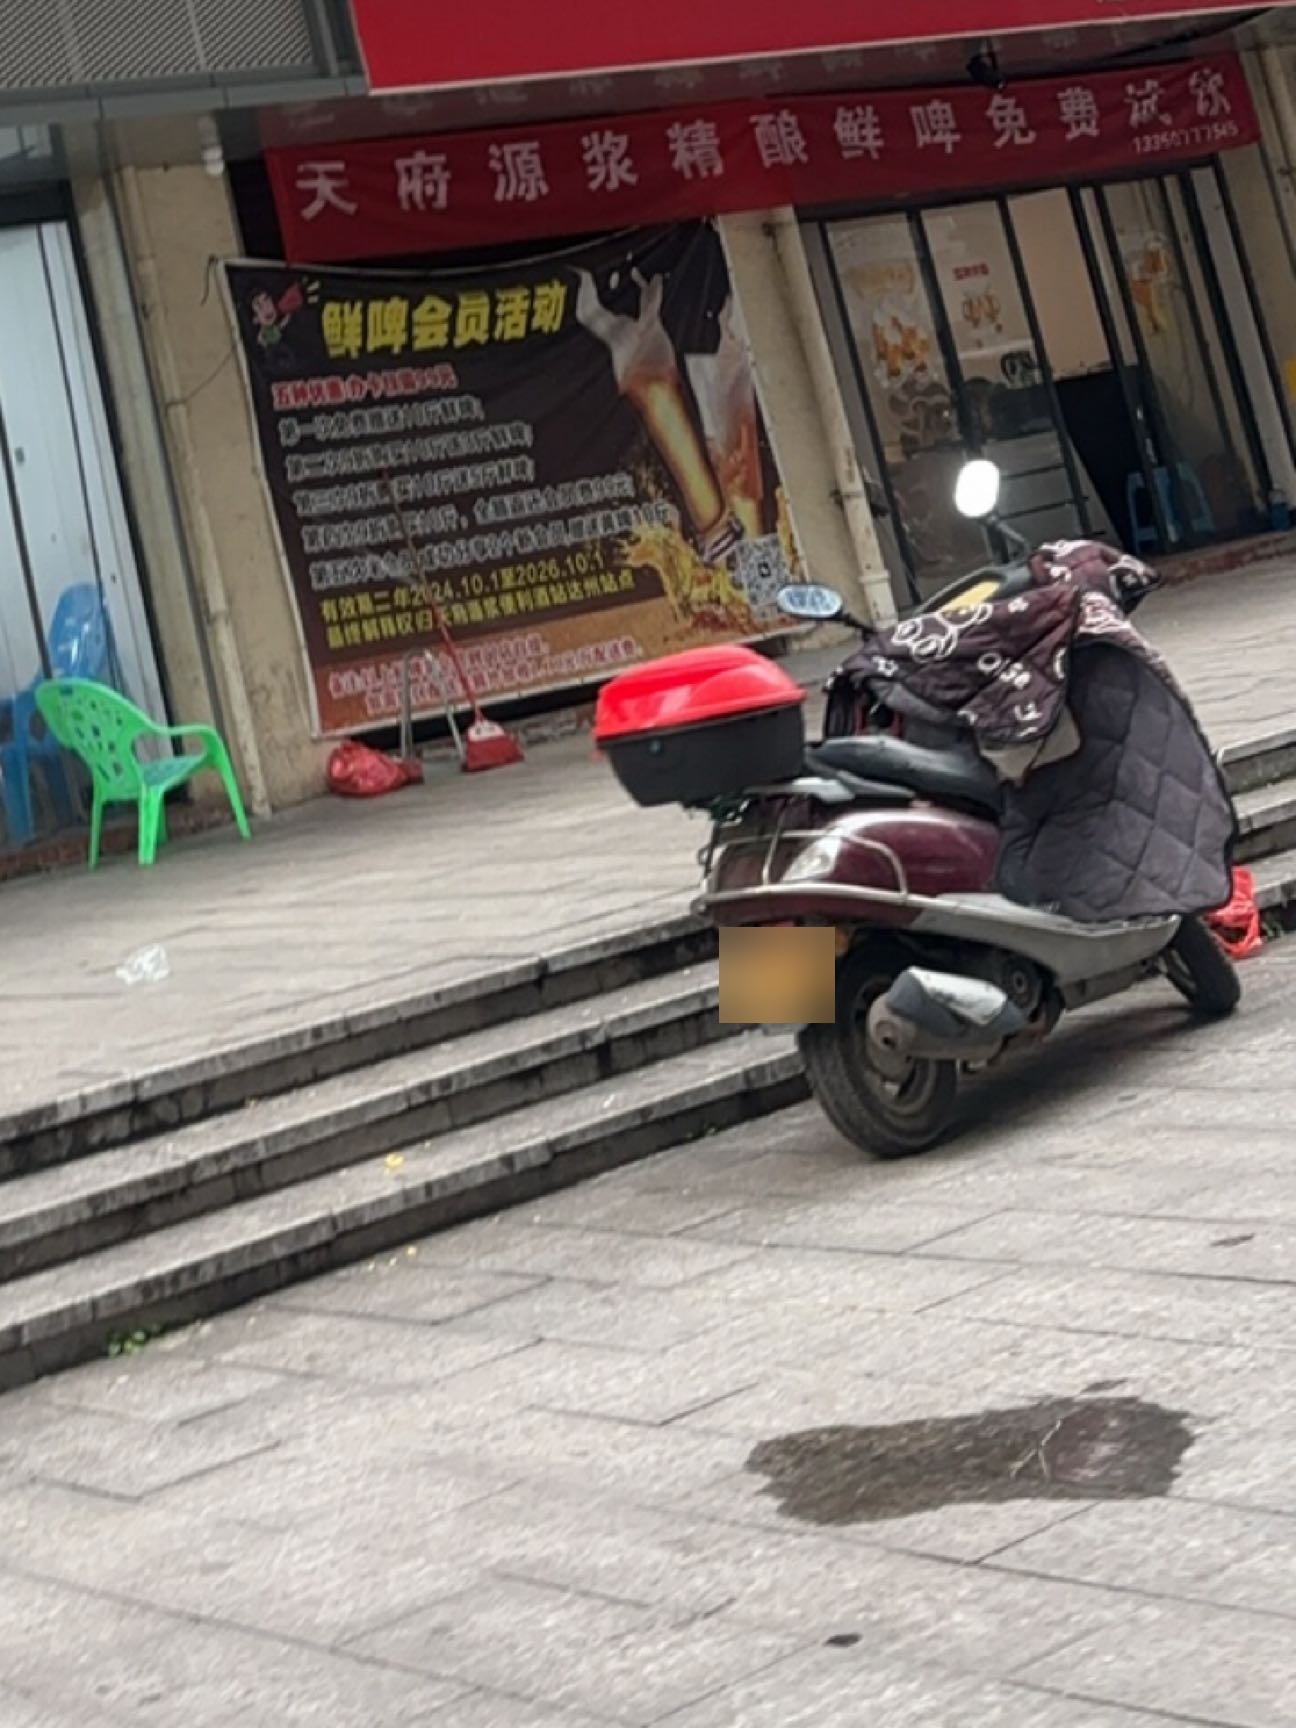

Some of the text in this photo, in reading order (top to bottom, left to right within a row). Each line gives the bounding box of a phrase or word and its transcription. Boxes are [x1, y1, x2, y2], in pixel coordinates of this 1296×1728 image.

[296, 68, 1232, 220] 天府源浆精酿鲜啤免费试饮
[322, 278, 568, 359] 鲜啤会员活动
